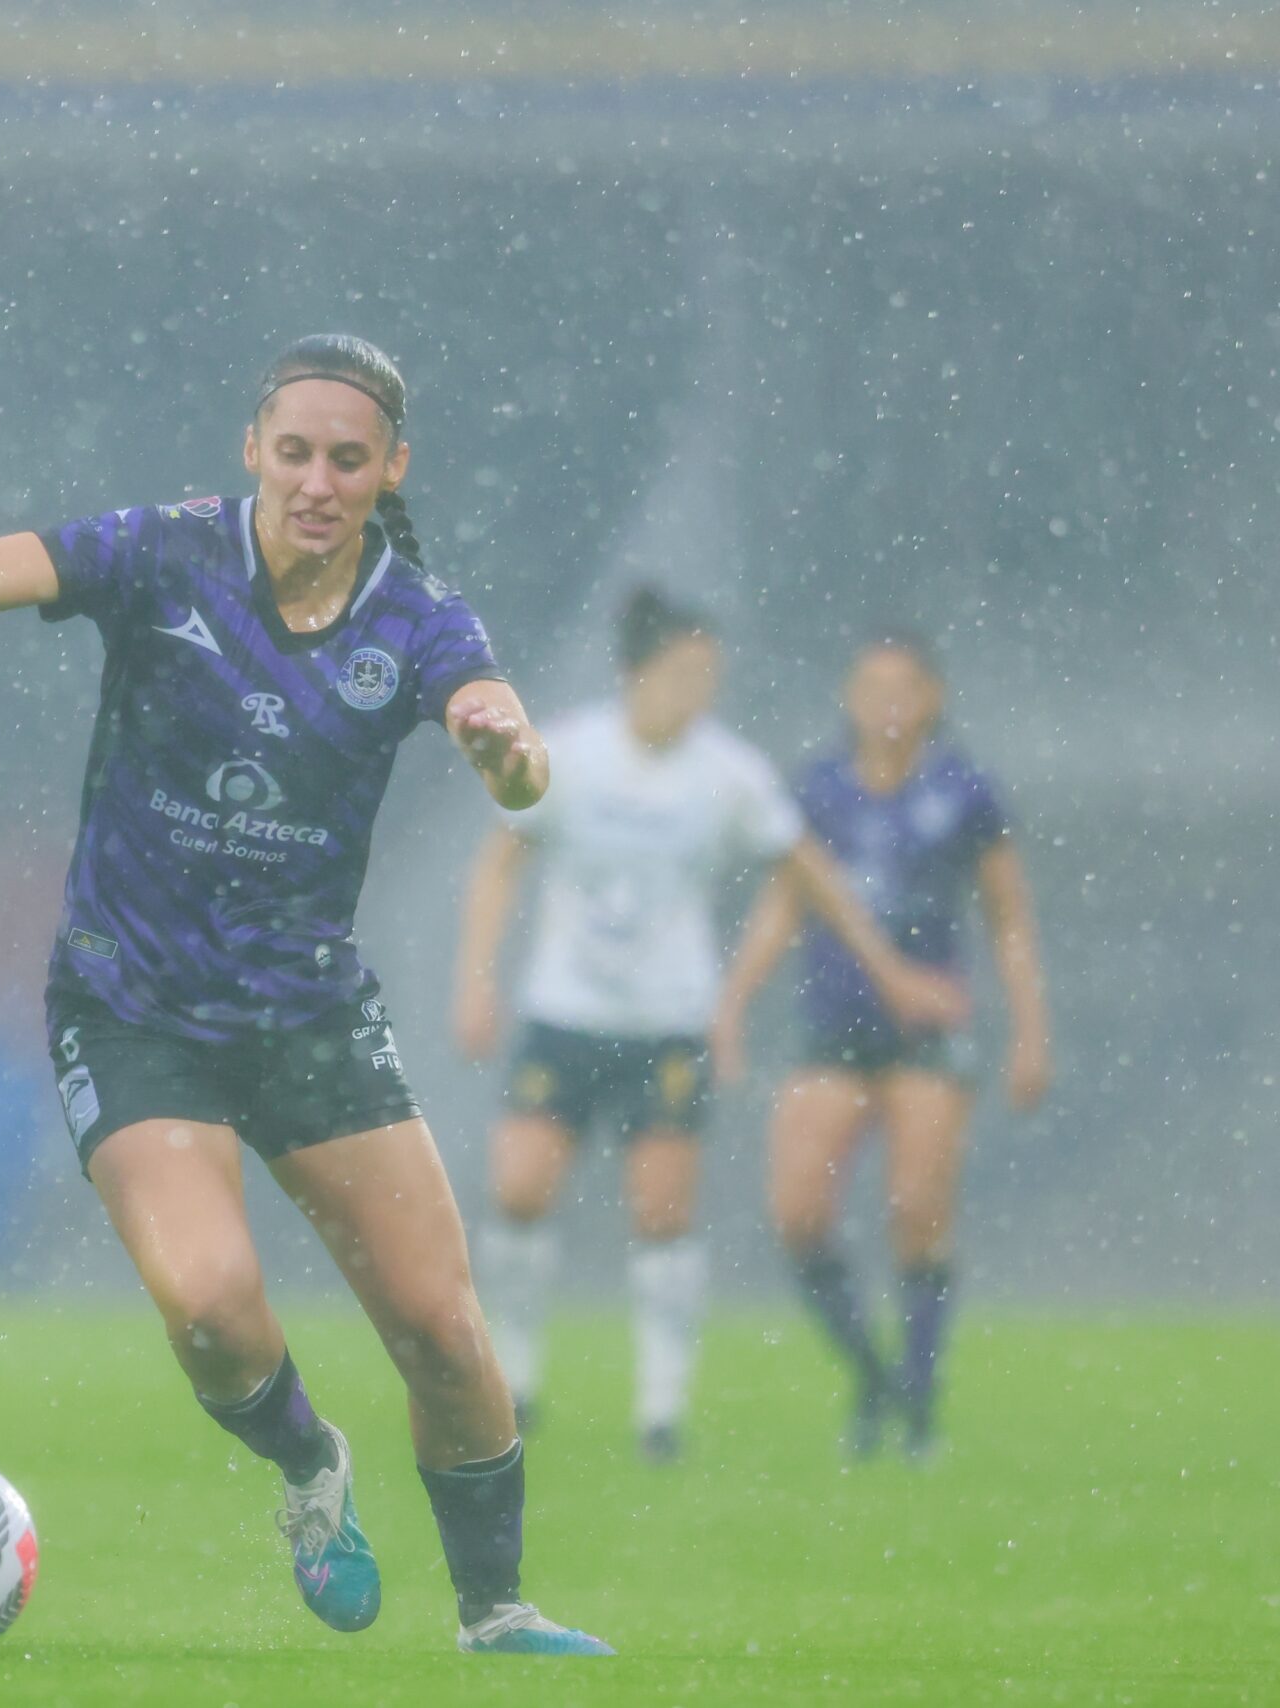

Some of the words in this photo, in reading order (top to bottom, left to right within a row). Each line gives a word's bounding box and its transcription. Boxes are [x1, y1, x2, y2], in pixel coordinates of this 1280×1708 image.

[150, 788, 219, 830] Banc
[223, 811, 329, 846] Azteca
[222, 839, 287, 863] Somos
